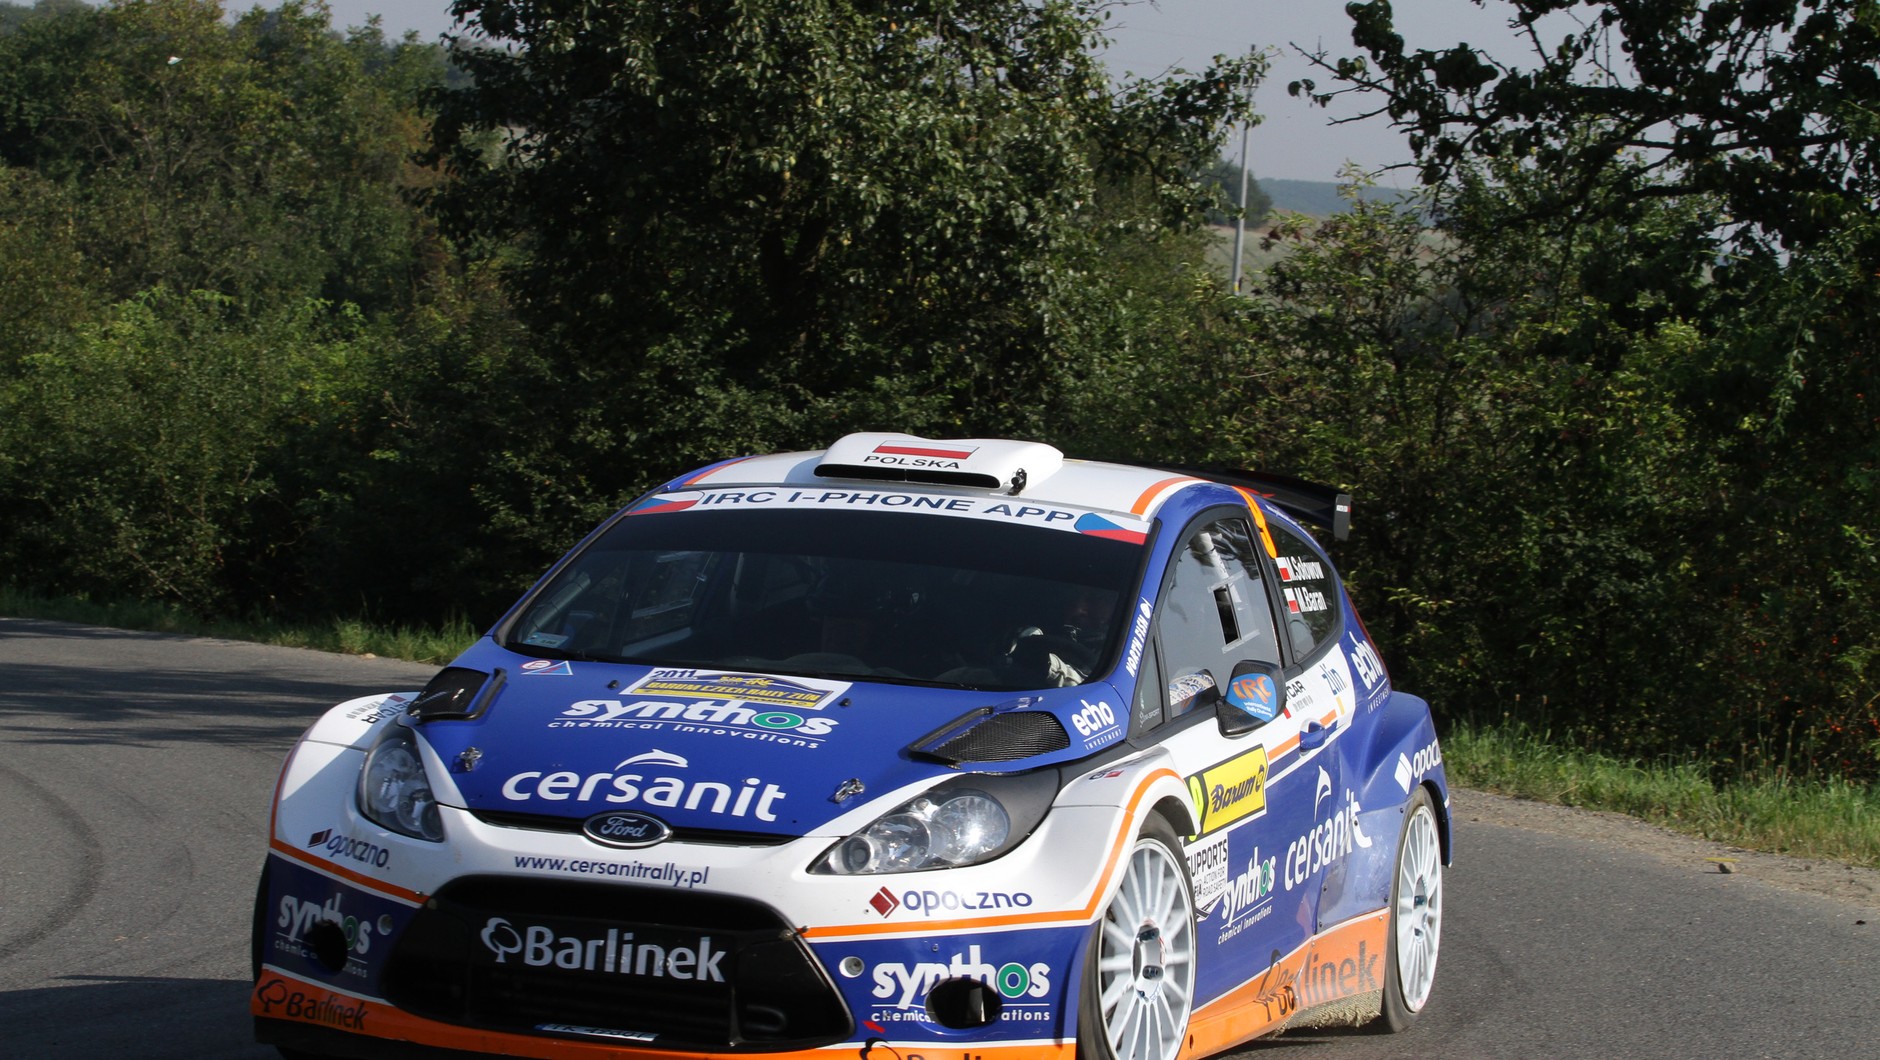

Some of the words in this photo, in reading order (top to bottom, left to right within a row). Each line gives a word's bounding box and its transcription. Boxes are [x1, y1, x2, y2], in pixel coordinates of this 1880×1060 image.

[864, 455, 961, 470] POLSKA
[701, 490, 776, 505] IRC
[782, 491, 977, 513] I-PHONE
[984, 503, 1076, 523] APP
[1134, 613, 1151, 644] FISH
[652, 670, 698, 679] 2011
[700, 684, 747, 695] CZECH
[547, 719, 663, 730] chemical
[673, 724, 819, 749] innovations
[562, 698, 840, 736] synthos
[1071, 699, 1115, 736] echo
[502, 771, 787, 822] cersanit
[1211, 775, 1256, 815] Barum
[600, 815, 649, 839] Ford
[1284, 788, 1373, 891] cersanit
[514, 854, 710, 889] www.cersanitrally.pl
[1221, 846, 1277, 928] synthos
[1218, 921, 1243, 945] chemical
[1243, 904, 1273, 935] innovations
[524, 926, 727, 983] Barlinek
[286, 991, 369, 1031] Barlinek
